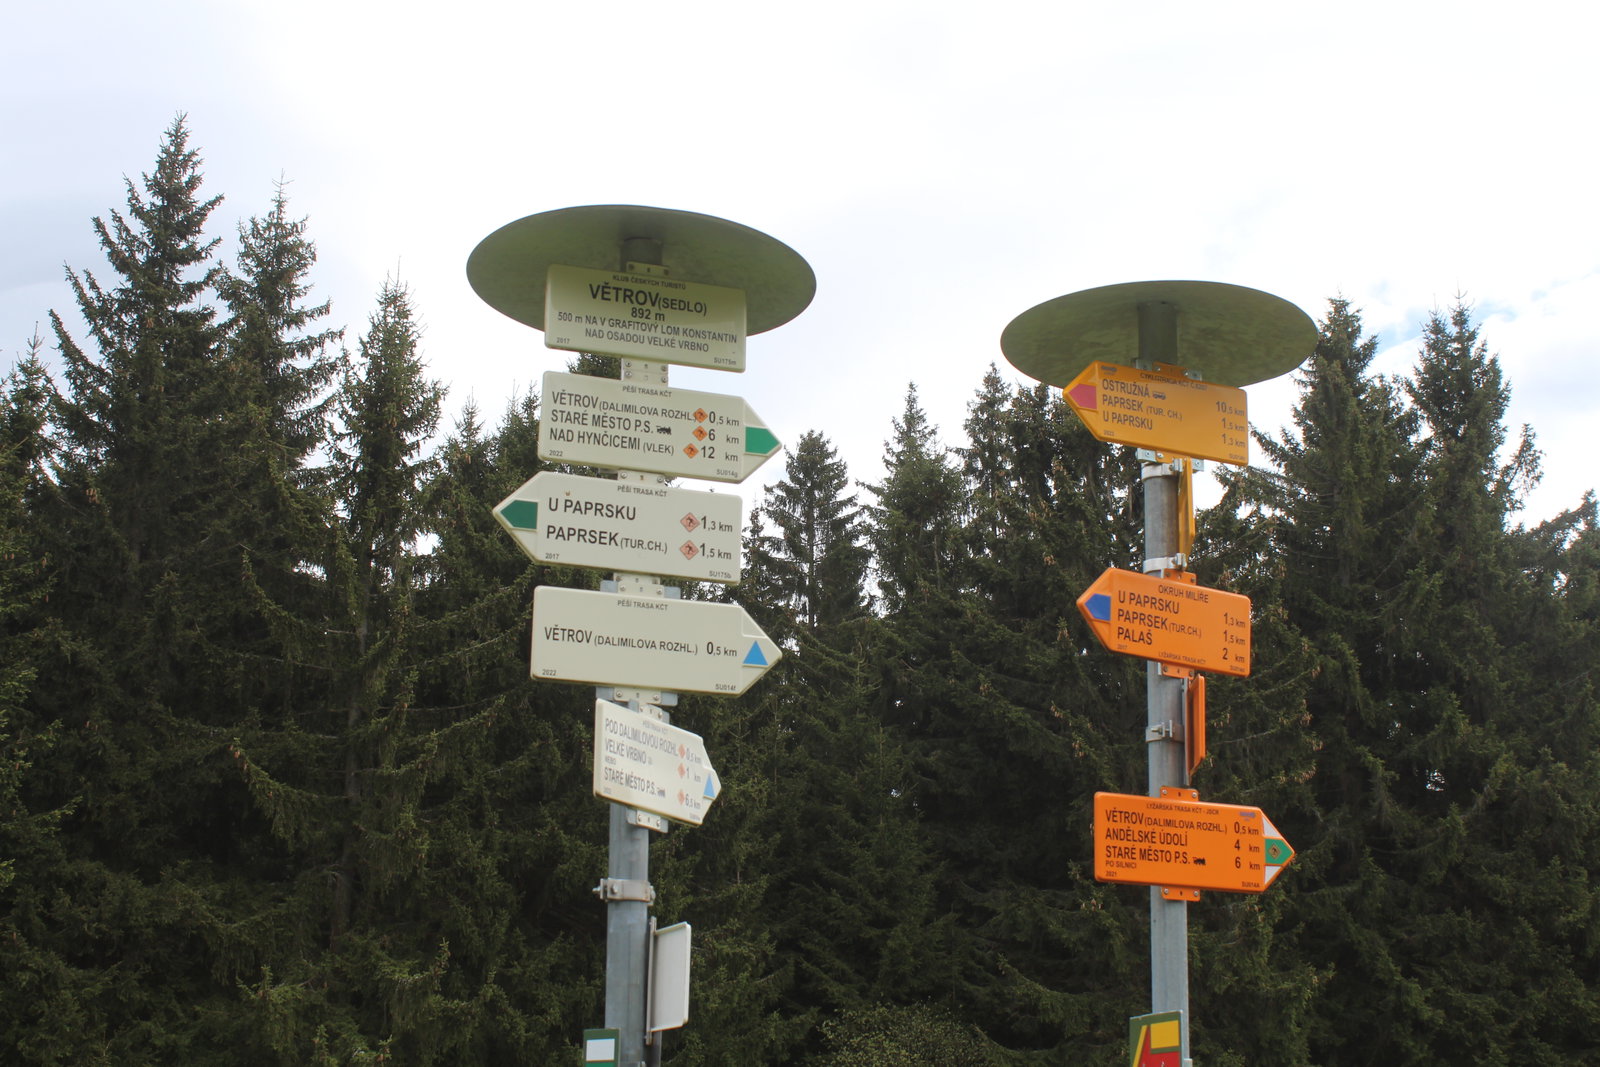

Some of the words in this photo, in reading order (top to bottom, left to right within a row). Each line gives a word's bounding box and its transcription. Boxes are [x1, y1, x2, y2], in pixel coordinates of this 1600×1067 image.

[590, 282, 658, 307] VĚTROV
[613, 275, 628, 283] KLUB
[631, 275, 659, 286] ČESKÝCH
[661, 280, 686, 290] TURISTŮ
[558, 312, 572, 322] 500
[585, 314, 597, 325] NA
[600, 316, 606, 326] V
[609, 317, 659, 332] GRAFITOVÝ
[661, 325, 679, 335] LOM
[683, 328, 737, 344] KONSTANTIN
[631, 308, 651, 319] 892
[655, 312, 665, 321] m
[586, 328, 604, 339] NAD
[607, 331, 644, 344] OSADOU
[648, 335, 675, 348] VELKÉ
[679, 340, 708, 352] VRBNO
[623, 385, 637, 393] PĚŠÍ
[638, 387, 658, 396] TRASA
[660, 389, 672, 397] KČT
[1102, 379, 1149, 398] OSTRUŽNÁ
[1234, 408, 1244, 416] km
[552, 390, 598, 409] VĚTROV
[600, 400, 659, 417] (DALIMILOVA
[726, 417, 739, 427] km
[1103, 394, 1143, 412] PAPRSEK
[1234, 424, 1245, 432] km
[1103, 412, 1109, 422] U
[1112, 413, 1152, 430] PAPRSKU
[551, 409, 588, 427] STARÉ
[592, 412, 631, 432] MĚSTO
[634, 420, 654, 434] P.S.
[708, 429, 715, 440] 6
[726, 435, 739, 444] km
[550, 427, 574, 442] NAD
[578, 430, 640, 451] HYNČICEMI
[643, 442, 674, 456] (VLEK)
[701, 446, 715, 459] 12
[725, 452, 738, 462] km
[633, 487, 652, 496] TRASA
[654, 488, 667, 497] KČT
[548, 498, 558, 511] U
[564, 499, 636, 520] PAPRSKU
[719, 522, 732, 532] km
[546, 525, 619, 546] PAPRSEK
[717, 550, 731, 560] km
[655, 602, 668, 611] KČT
[1158, 585, 1184, 597] OKRUH
[1119, 591, 1125, 603] U
[1129, 593, 1179, 614] PAPRSKU
[1236, 618, 1245, 628] km
[545, 624, 592, 644] VĚTROV
[594, 634, 657, 650] (DALIMILOVA
[660, 640, 698, 655] ROZHL.)
[723, 648, 737, 657] km
[1118, 609, 1168, 630] PAPRSEK
[1236, 635, 1245, 645] km
[1118, 627, 1152, 645] PALAŠ
[1223, 648, 1228, 660] 2
[1235, 653, 1244, 663] km
[606, 718, 618, 734] POD
[620, 723, 659, 749] DALIMILOVOU
[606, 739, 624, 757] VELKÉ
[626, 746, 646, 765] VRBNO
[687, 768, 689, 778] 1
[604, 766, 623, 785] STARÉ
[625, 771, 645, 792] MĚSTO
[646, 781, 656, 795] P.S.
[694, 800, 700, 809] km
[1106, 808, 1143, 825] VĚTROV
[1144, 816, 1194, 830] (DALIMILOVA
[1197, 821, 1227, 835] ROZHL.)
[1248, 827, 1259, 835] km
[1106, 827, 1156, 844] ANDĚLSKÉ
[1160, 829, 1188, 847] ÚDOLÍ
[1234, 840, 1240, 850] 4
[1249, 844, 1260, 852] km
[1106, 844, 1136, 860] STARÉ
[1139, 844, 1172, 863] MĚSTO
[1175, 852, 1190, 865] P.S.
[1235, 856, 1241, 869] 6
[1249, 862, 1260, 871] km
